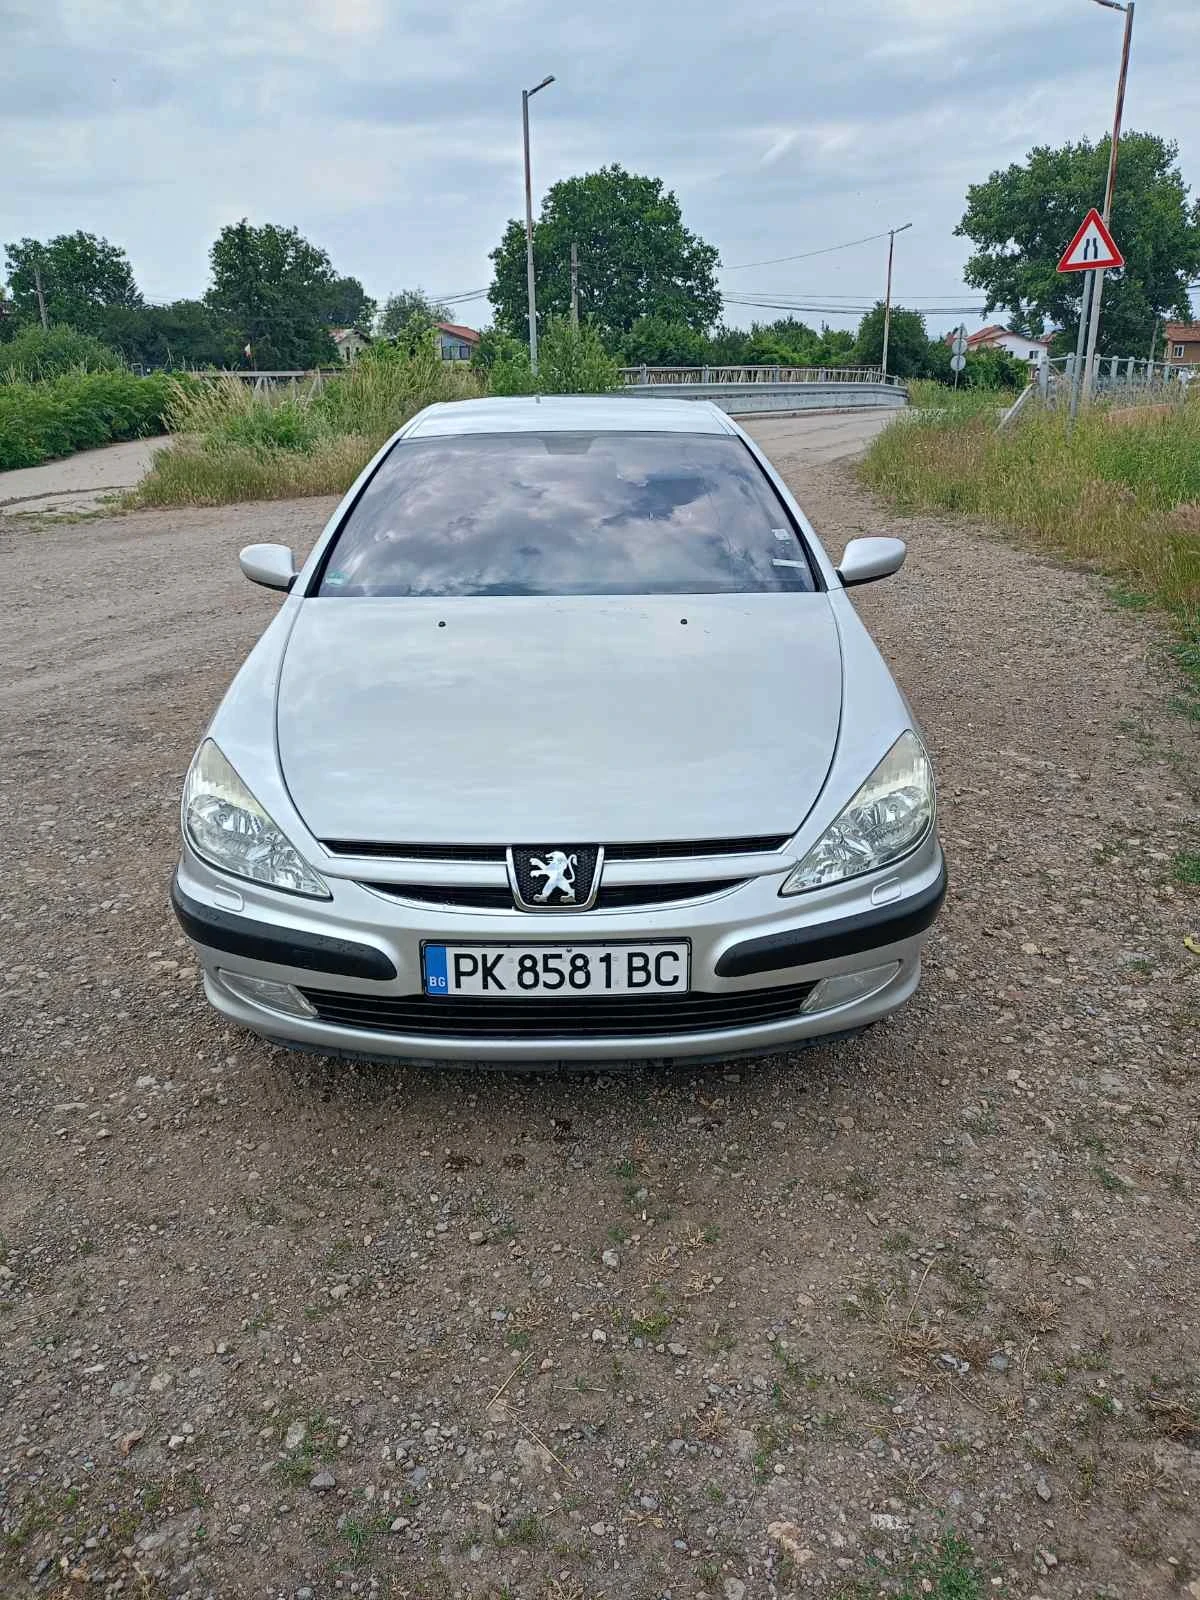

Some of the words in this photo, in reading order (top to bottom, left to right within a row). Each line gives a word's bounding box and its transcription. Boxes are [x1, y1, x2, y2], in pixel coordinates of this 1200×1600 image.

[429, 976, 446, 987] BG
[453, 953, 506, 990] PK
[517, 952, 612, 990] 8581
[626, 951, 680, 988] BC
